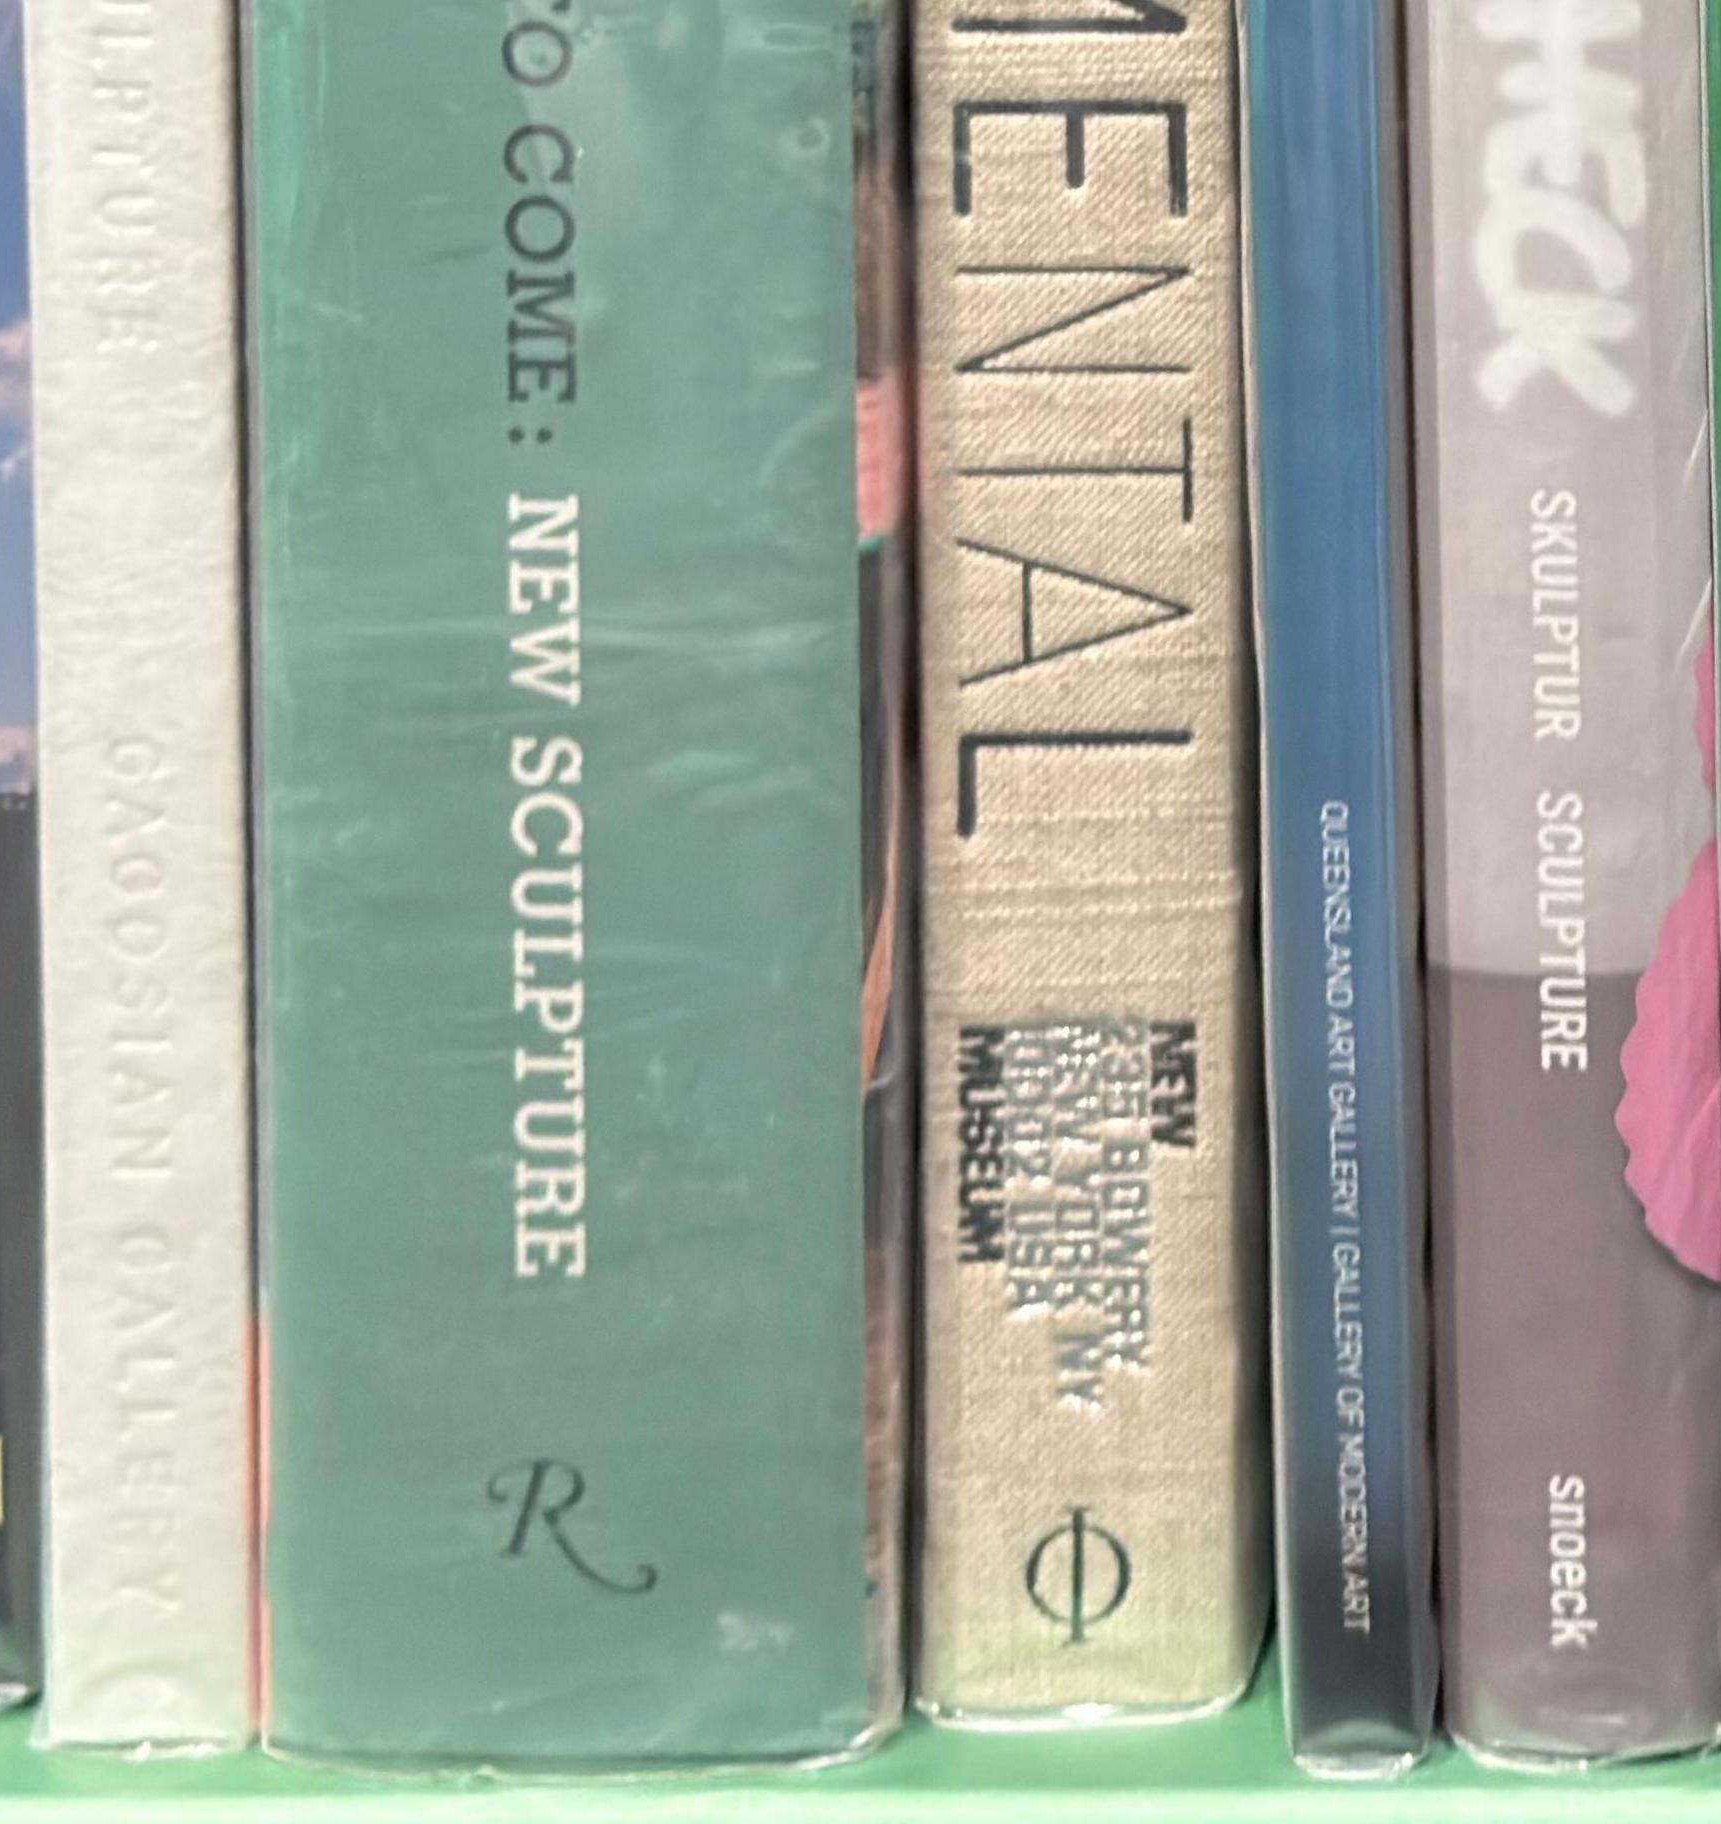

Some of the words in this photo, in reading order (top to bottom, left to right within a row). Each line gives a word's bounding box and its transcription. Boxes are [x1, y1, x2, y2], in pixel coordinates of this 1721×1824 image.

[507, 491, 582, 708] NEW
[1529, 488, 1582, 742] SKULPTUR
[1319, 798, 1354, 1010] QUEENSLAND
[1535, 788, 1589, 1072] SCULPTURE
[509, 735, 588, 1278] SCULPTURE
[1150, 1019, 1198, 1151] NEW
[1326, 1011, 1356, 1078] ART
[959, 1024, 1007, 1264] MUSEUM
[1328, 1080, 1360, 1219] GALLERY
[1332, 1243, 1365, 1380] GALLERY
[1335, 1385, 1366, 1429] OF
[1337, 1432, 1368, 1568] MODERN
[1548, 1474, 1599, 1650] snoeck
[1341, 1572, 1371, 1636] ART
